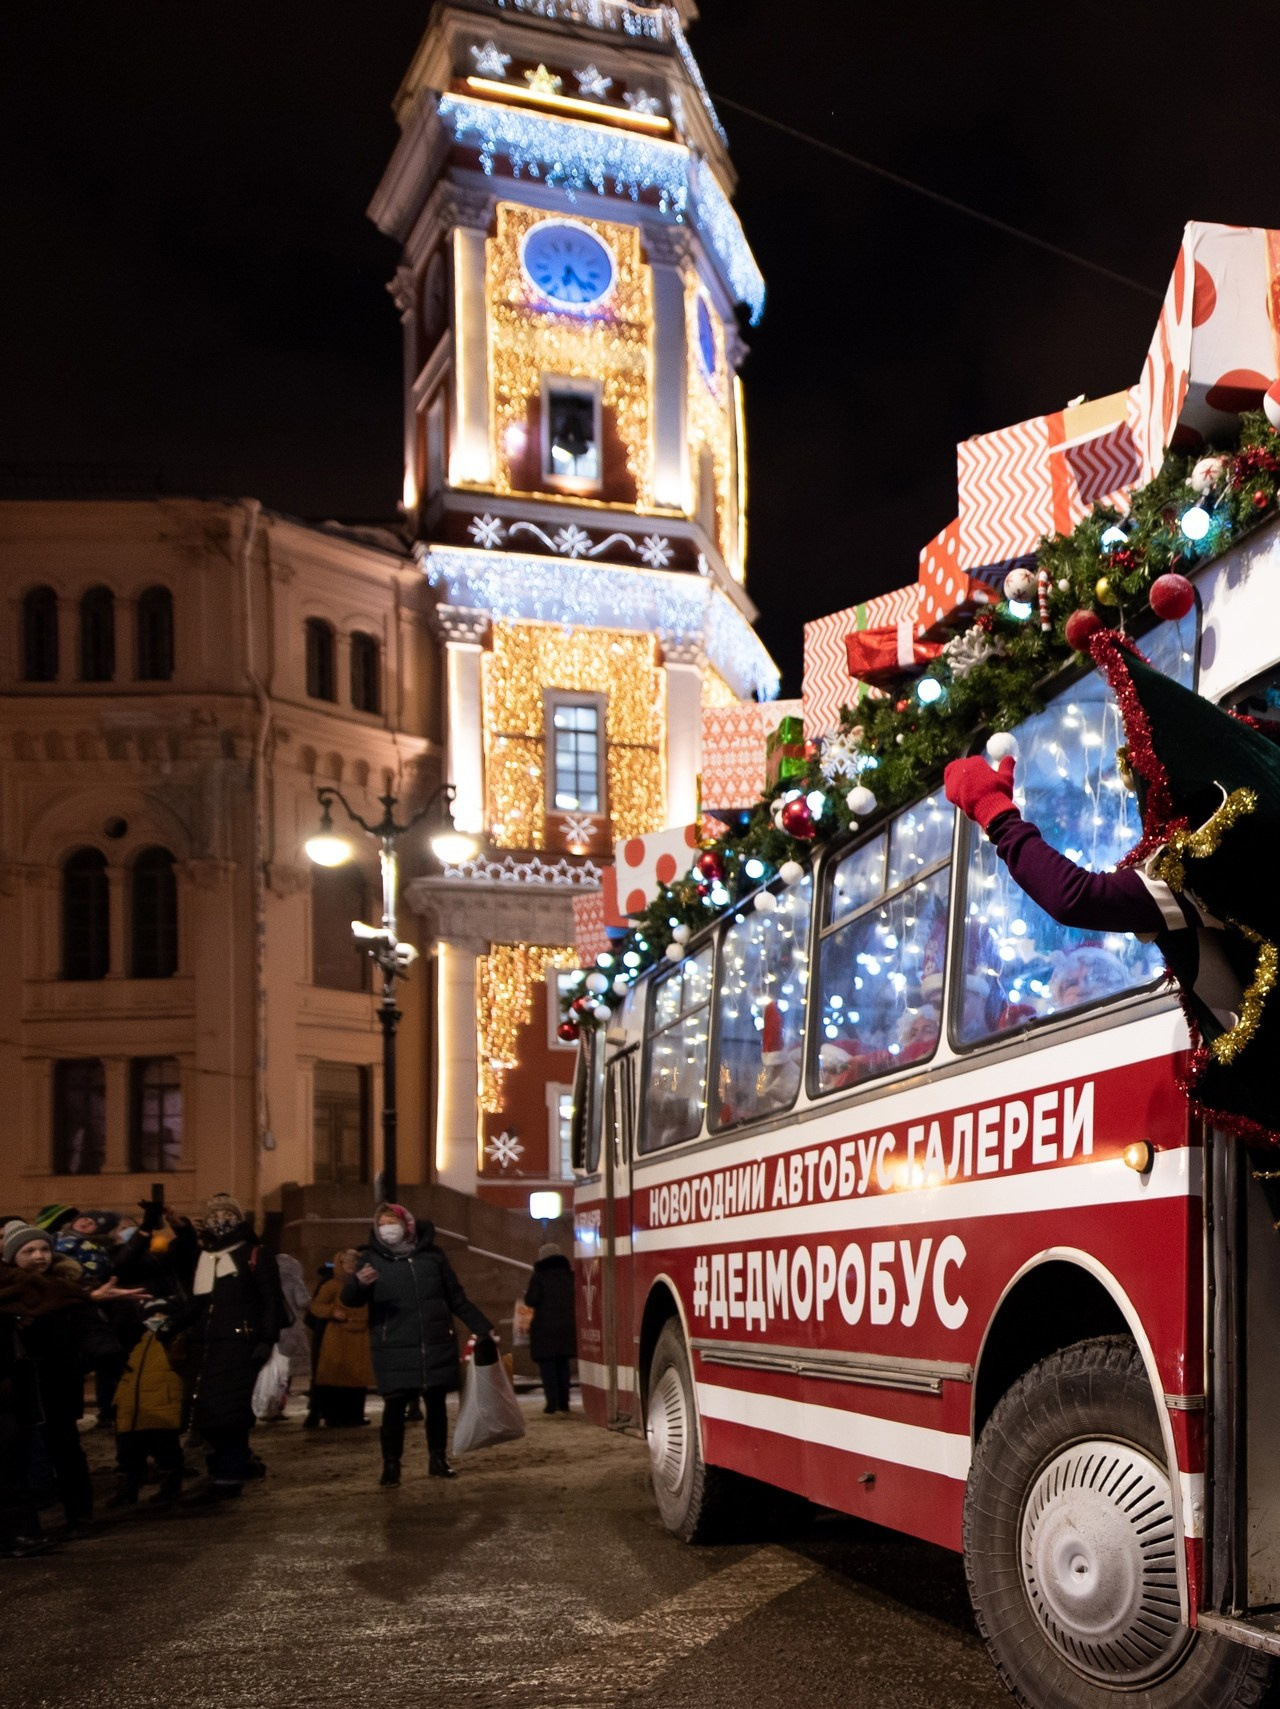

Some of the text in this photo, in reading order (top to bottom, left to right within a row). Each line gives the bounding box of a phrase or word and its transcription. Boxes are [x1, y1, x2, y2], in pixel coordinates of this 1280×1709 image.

[650, 1081, 1095, 1221] НОВОГОДНИЙ АВТОБУС ГАЛЕРЕИ
[693, 1234, 969, 1332] #ДЕДМОРОБУС
